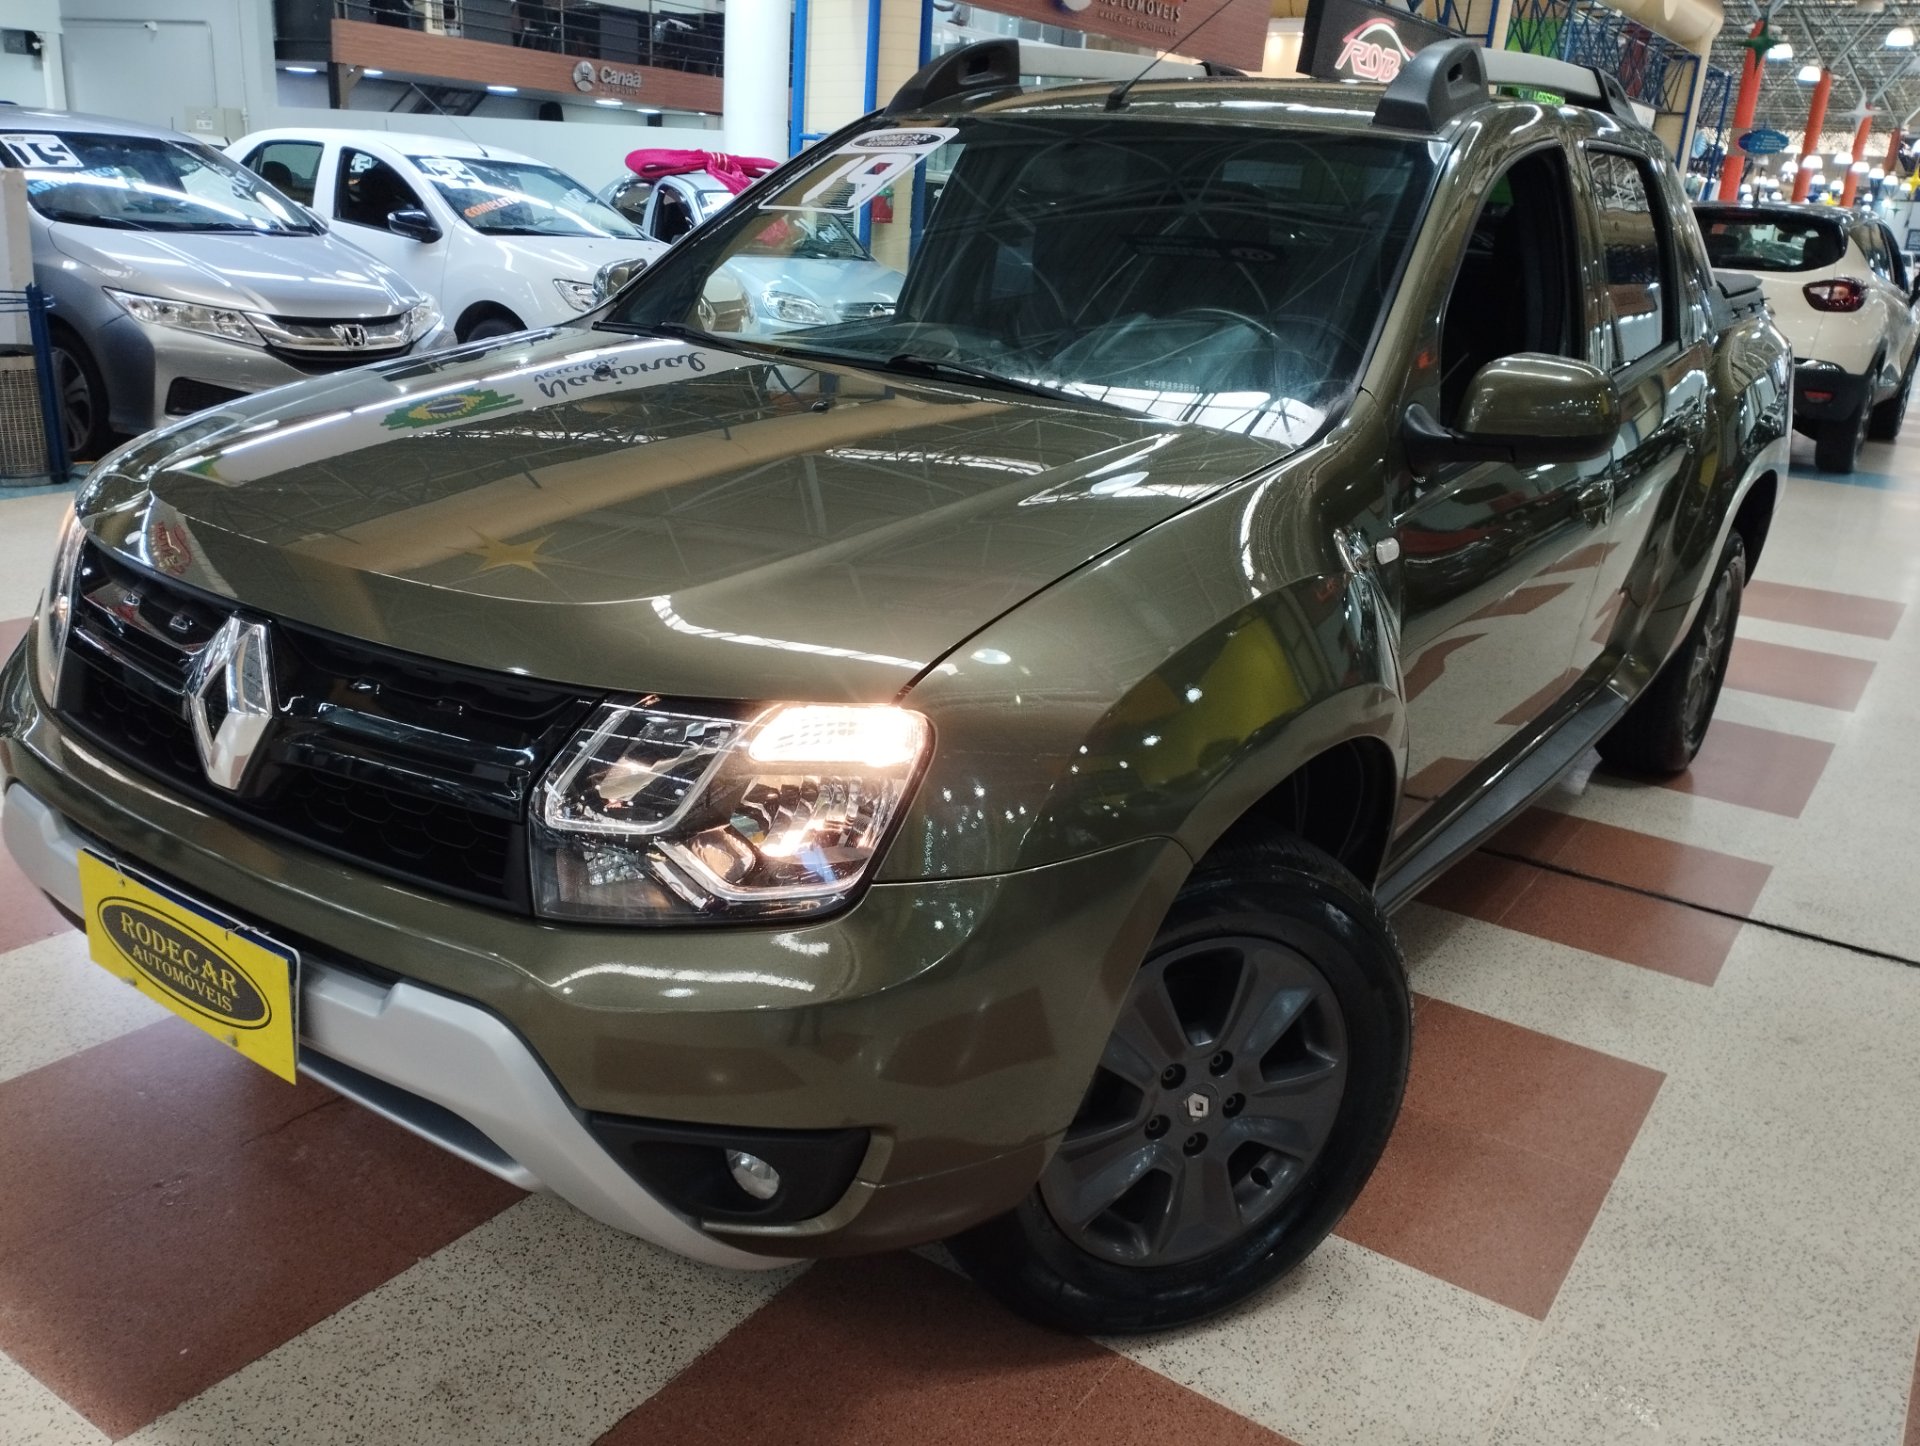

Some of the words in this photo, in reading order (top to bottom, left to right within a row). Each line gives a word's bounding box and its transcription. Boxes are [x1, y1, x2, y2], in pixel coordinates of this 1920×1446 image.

[8, 143, 81, 166] 15
[802, 154, 913, 207] 19
[120, 911, 240, 999] RODECAR
[131, 944, 233, 1013] AUTOMÓVEIS
